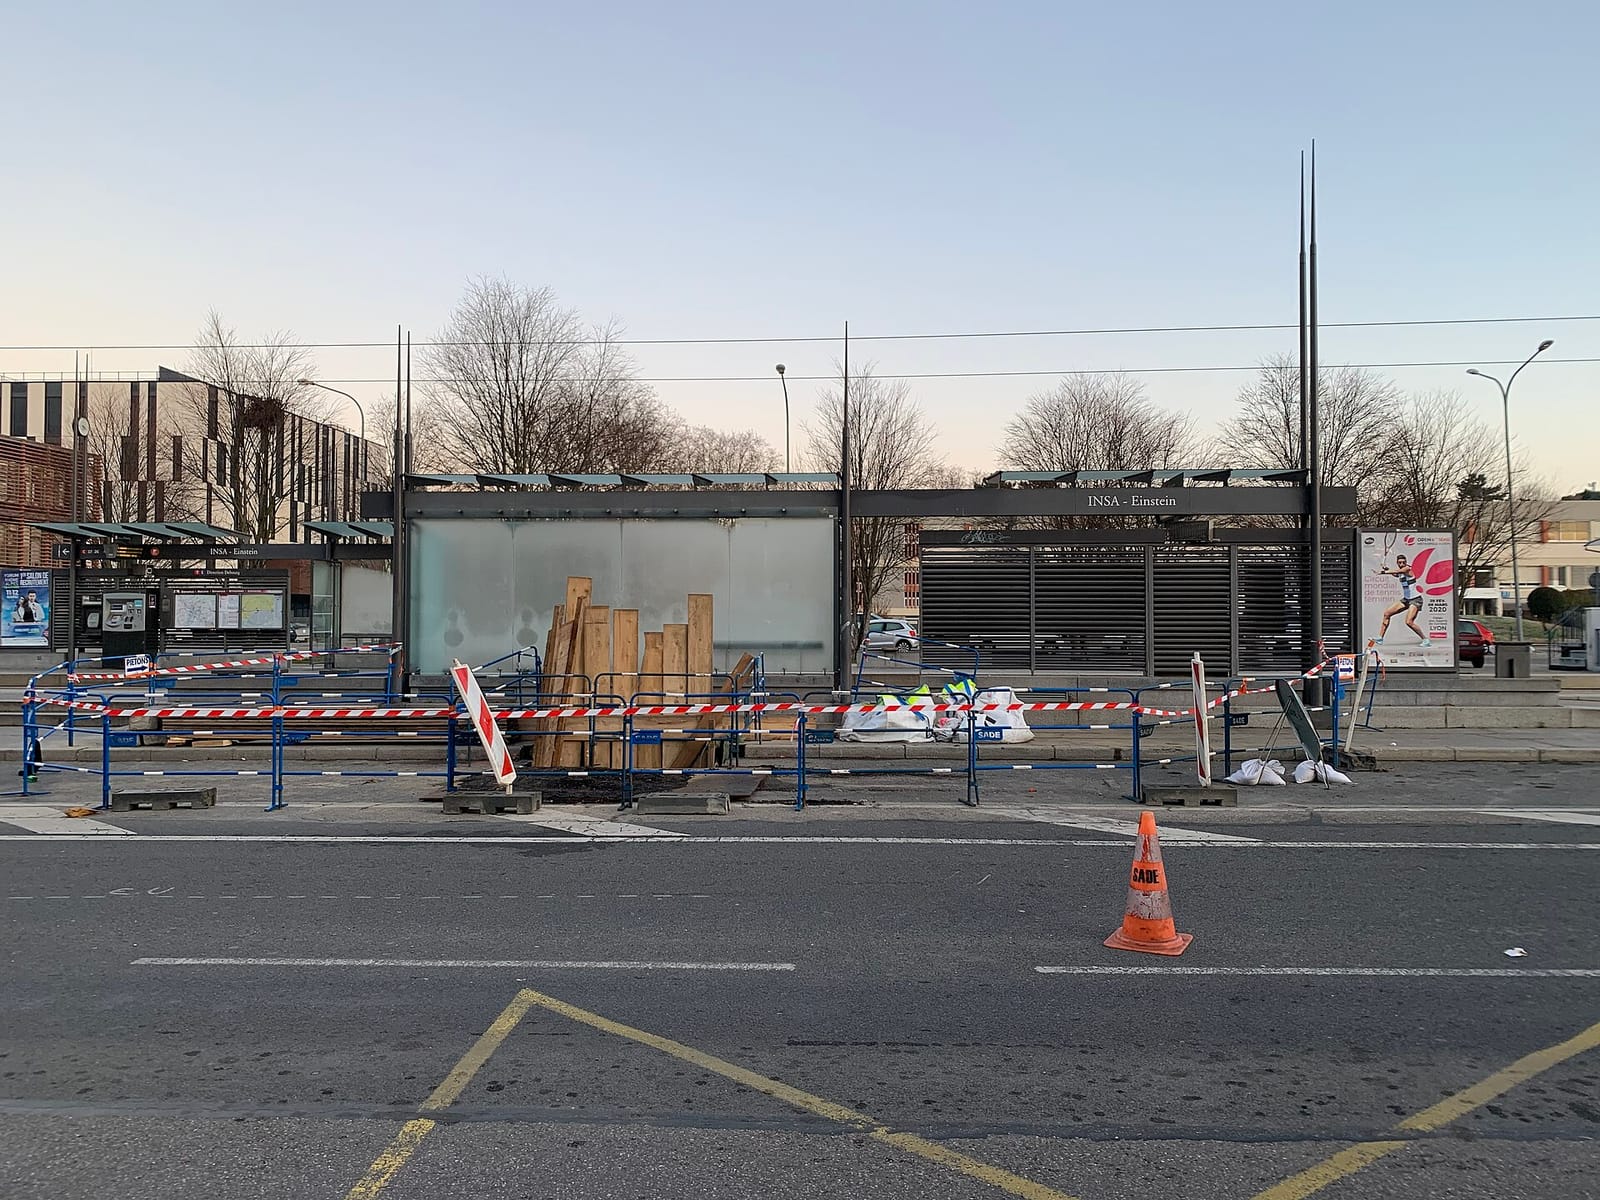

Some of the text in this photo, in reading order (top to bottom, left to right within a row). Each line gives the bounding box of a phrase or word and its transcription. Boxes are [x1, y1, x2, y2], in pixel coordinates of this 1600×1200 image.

[1088, 495, 1120, 506] INSA
[1131, 495, 1176, 506] Einstein
[210, 547, 228, 556] INSA
[233, 547, 258, 556] Einstein
[978, 731, 1001, 739] SADE
[1132, 868, 1160, 884] SADE
